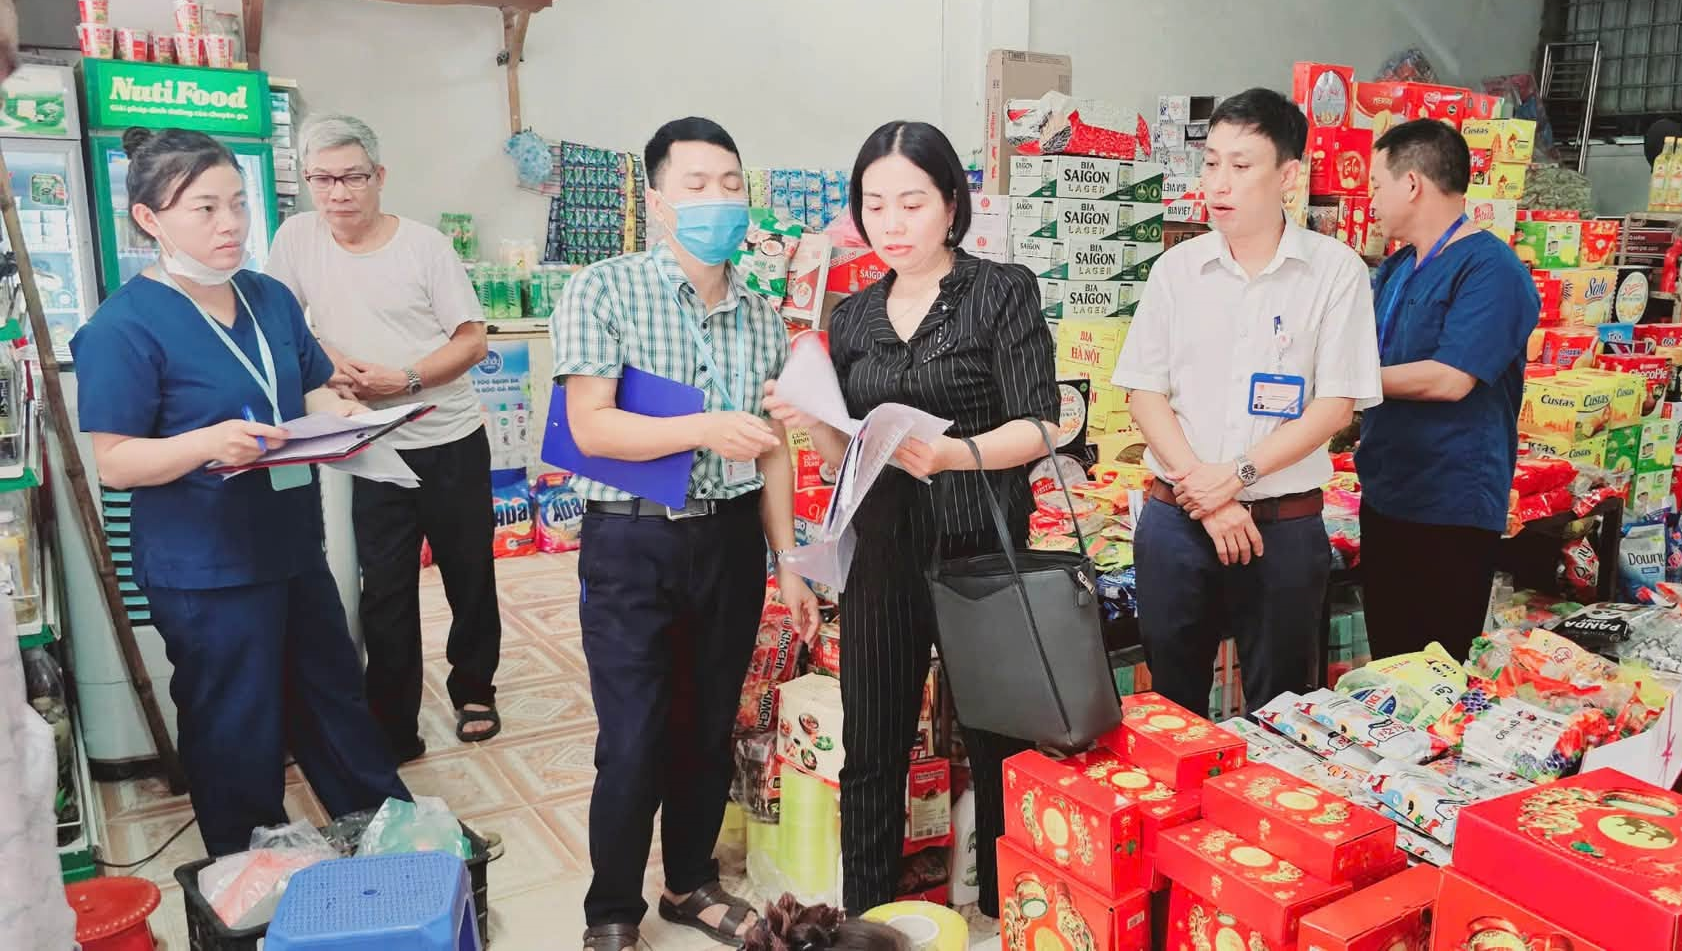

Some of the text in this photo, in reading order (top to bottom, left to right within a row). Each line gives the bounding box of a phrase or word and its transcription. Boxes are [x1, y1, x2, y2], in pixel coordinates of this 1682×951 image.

[1080, 161, 1095, 170] BIA
[1064, 169, 1110, 184] SAIGON
[1068, 183, 1105, 194] LAGER
[1080, 203, 1095, 211] BIA
[1064, 211, 1110, 225] SAIGON
[1068, 225, 1105, 235] LAGER
[1089, 243, 1103, 252] BIA
[1075, 252, 1116, 265] SAIGON
[1079, 266, 1112, 275] LAGER
[1084, 284, 1098, 292] BIA
[1069, 292, 1112, 305] SAIGON
[1073, 306, 1108, 315] LAGER
[1080, 331, 1093, 342] BIA
[1071, 347, 1100, 365] HÀ NỘI
[1540, 394, 1575, 408] Custas
[1583, 394, 1610, 407] Custas
[494, 502, 528, 527] Aba
[1564, 620, 1621, 631] PANDA
[776, 629, 792, 670] KIMCHI
[757, 690, 773, 731] KIMCHI
